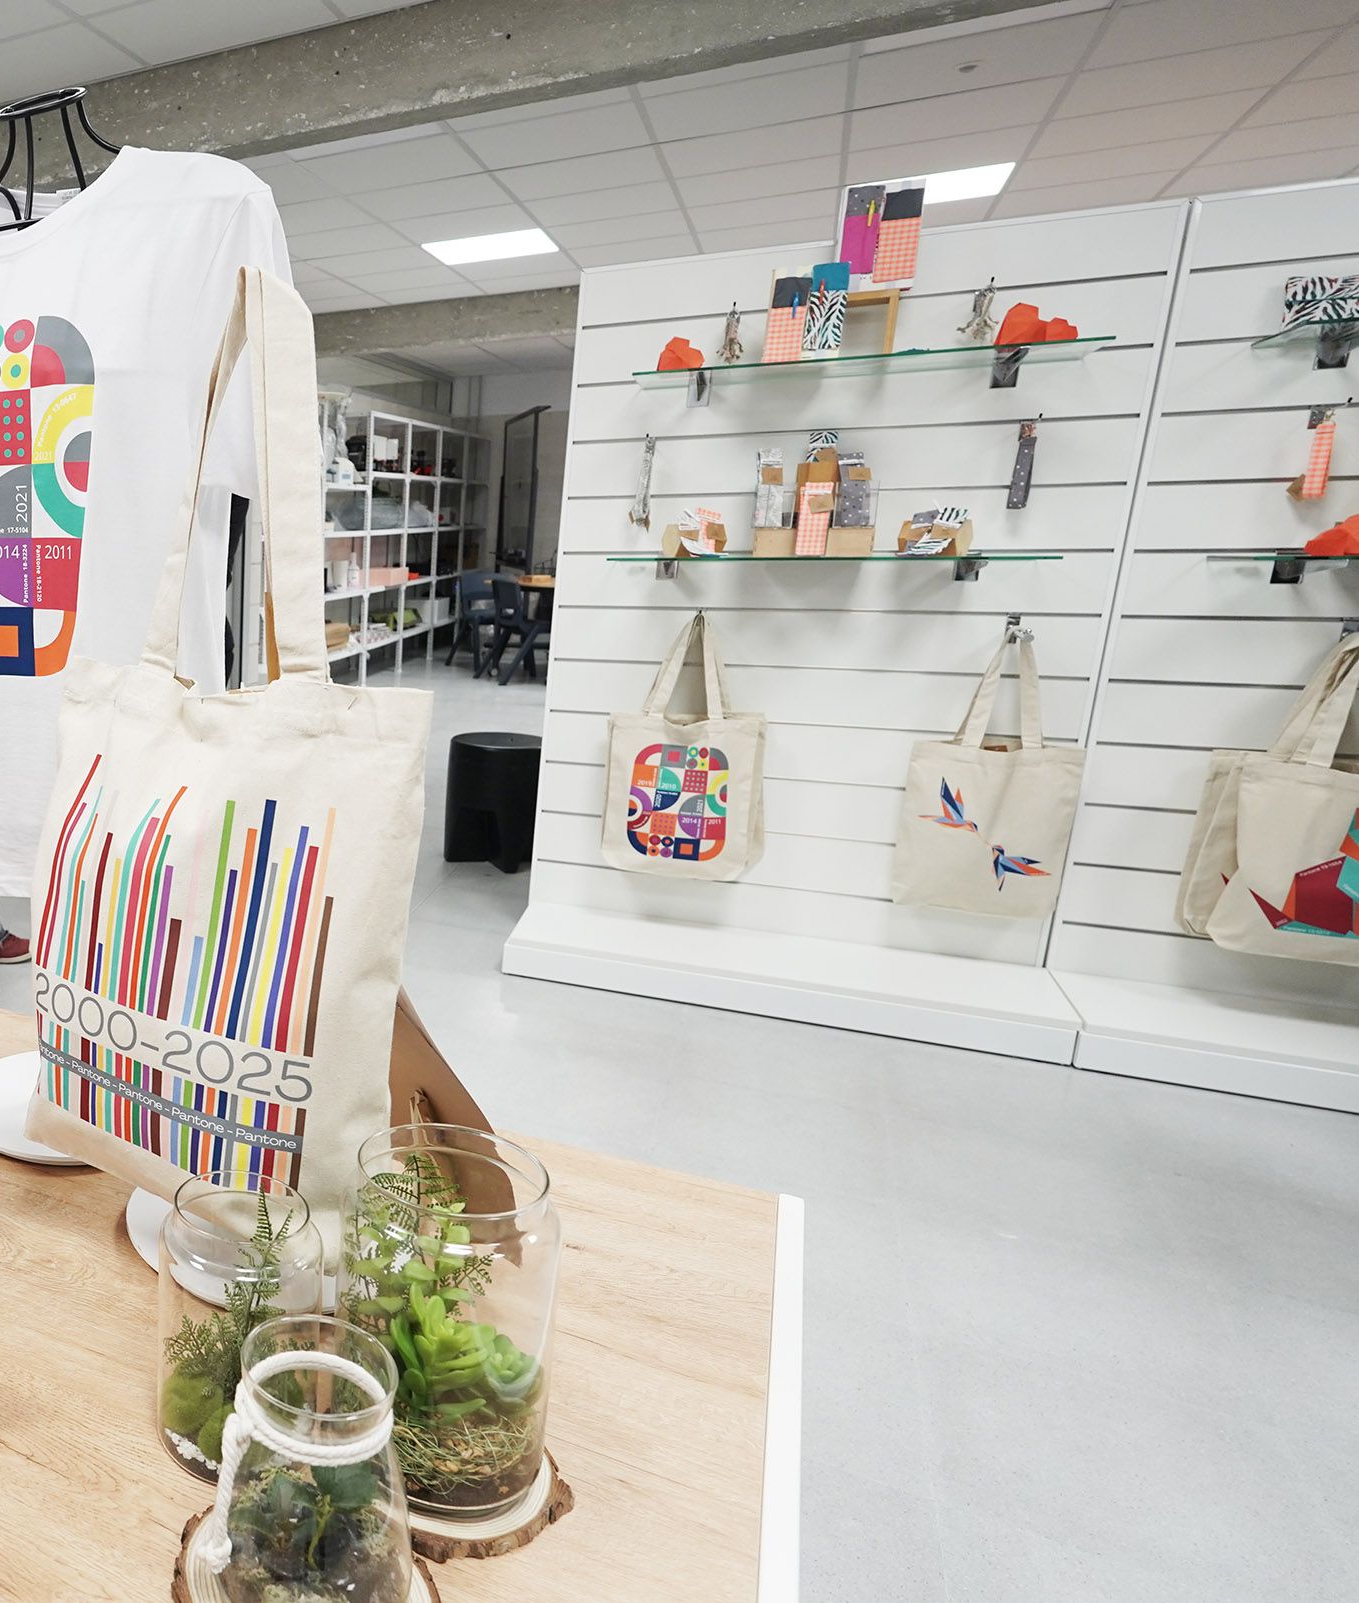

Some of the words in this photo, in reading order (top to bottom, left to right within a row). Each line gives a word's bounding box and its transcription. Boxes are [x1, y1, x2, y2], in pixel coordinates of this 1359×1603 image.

[15, 485, 28, 523] 2021
[44, 544, 73, 560] 2011
[35, 972, 313, 1102] 2000-2025
[41, 1046, 65, 1065] ntone
[71, 1060, 111, 1087] Pantone
[118, 1082, 163, 1111] Pantone
[171, 1106, 224, 1133] Pantone
[235, 1128, 297, 1149] Pantone
